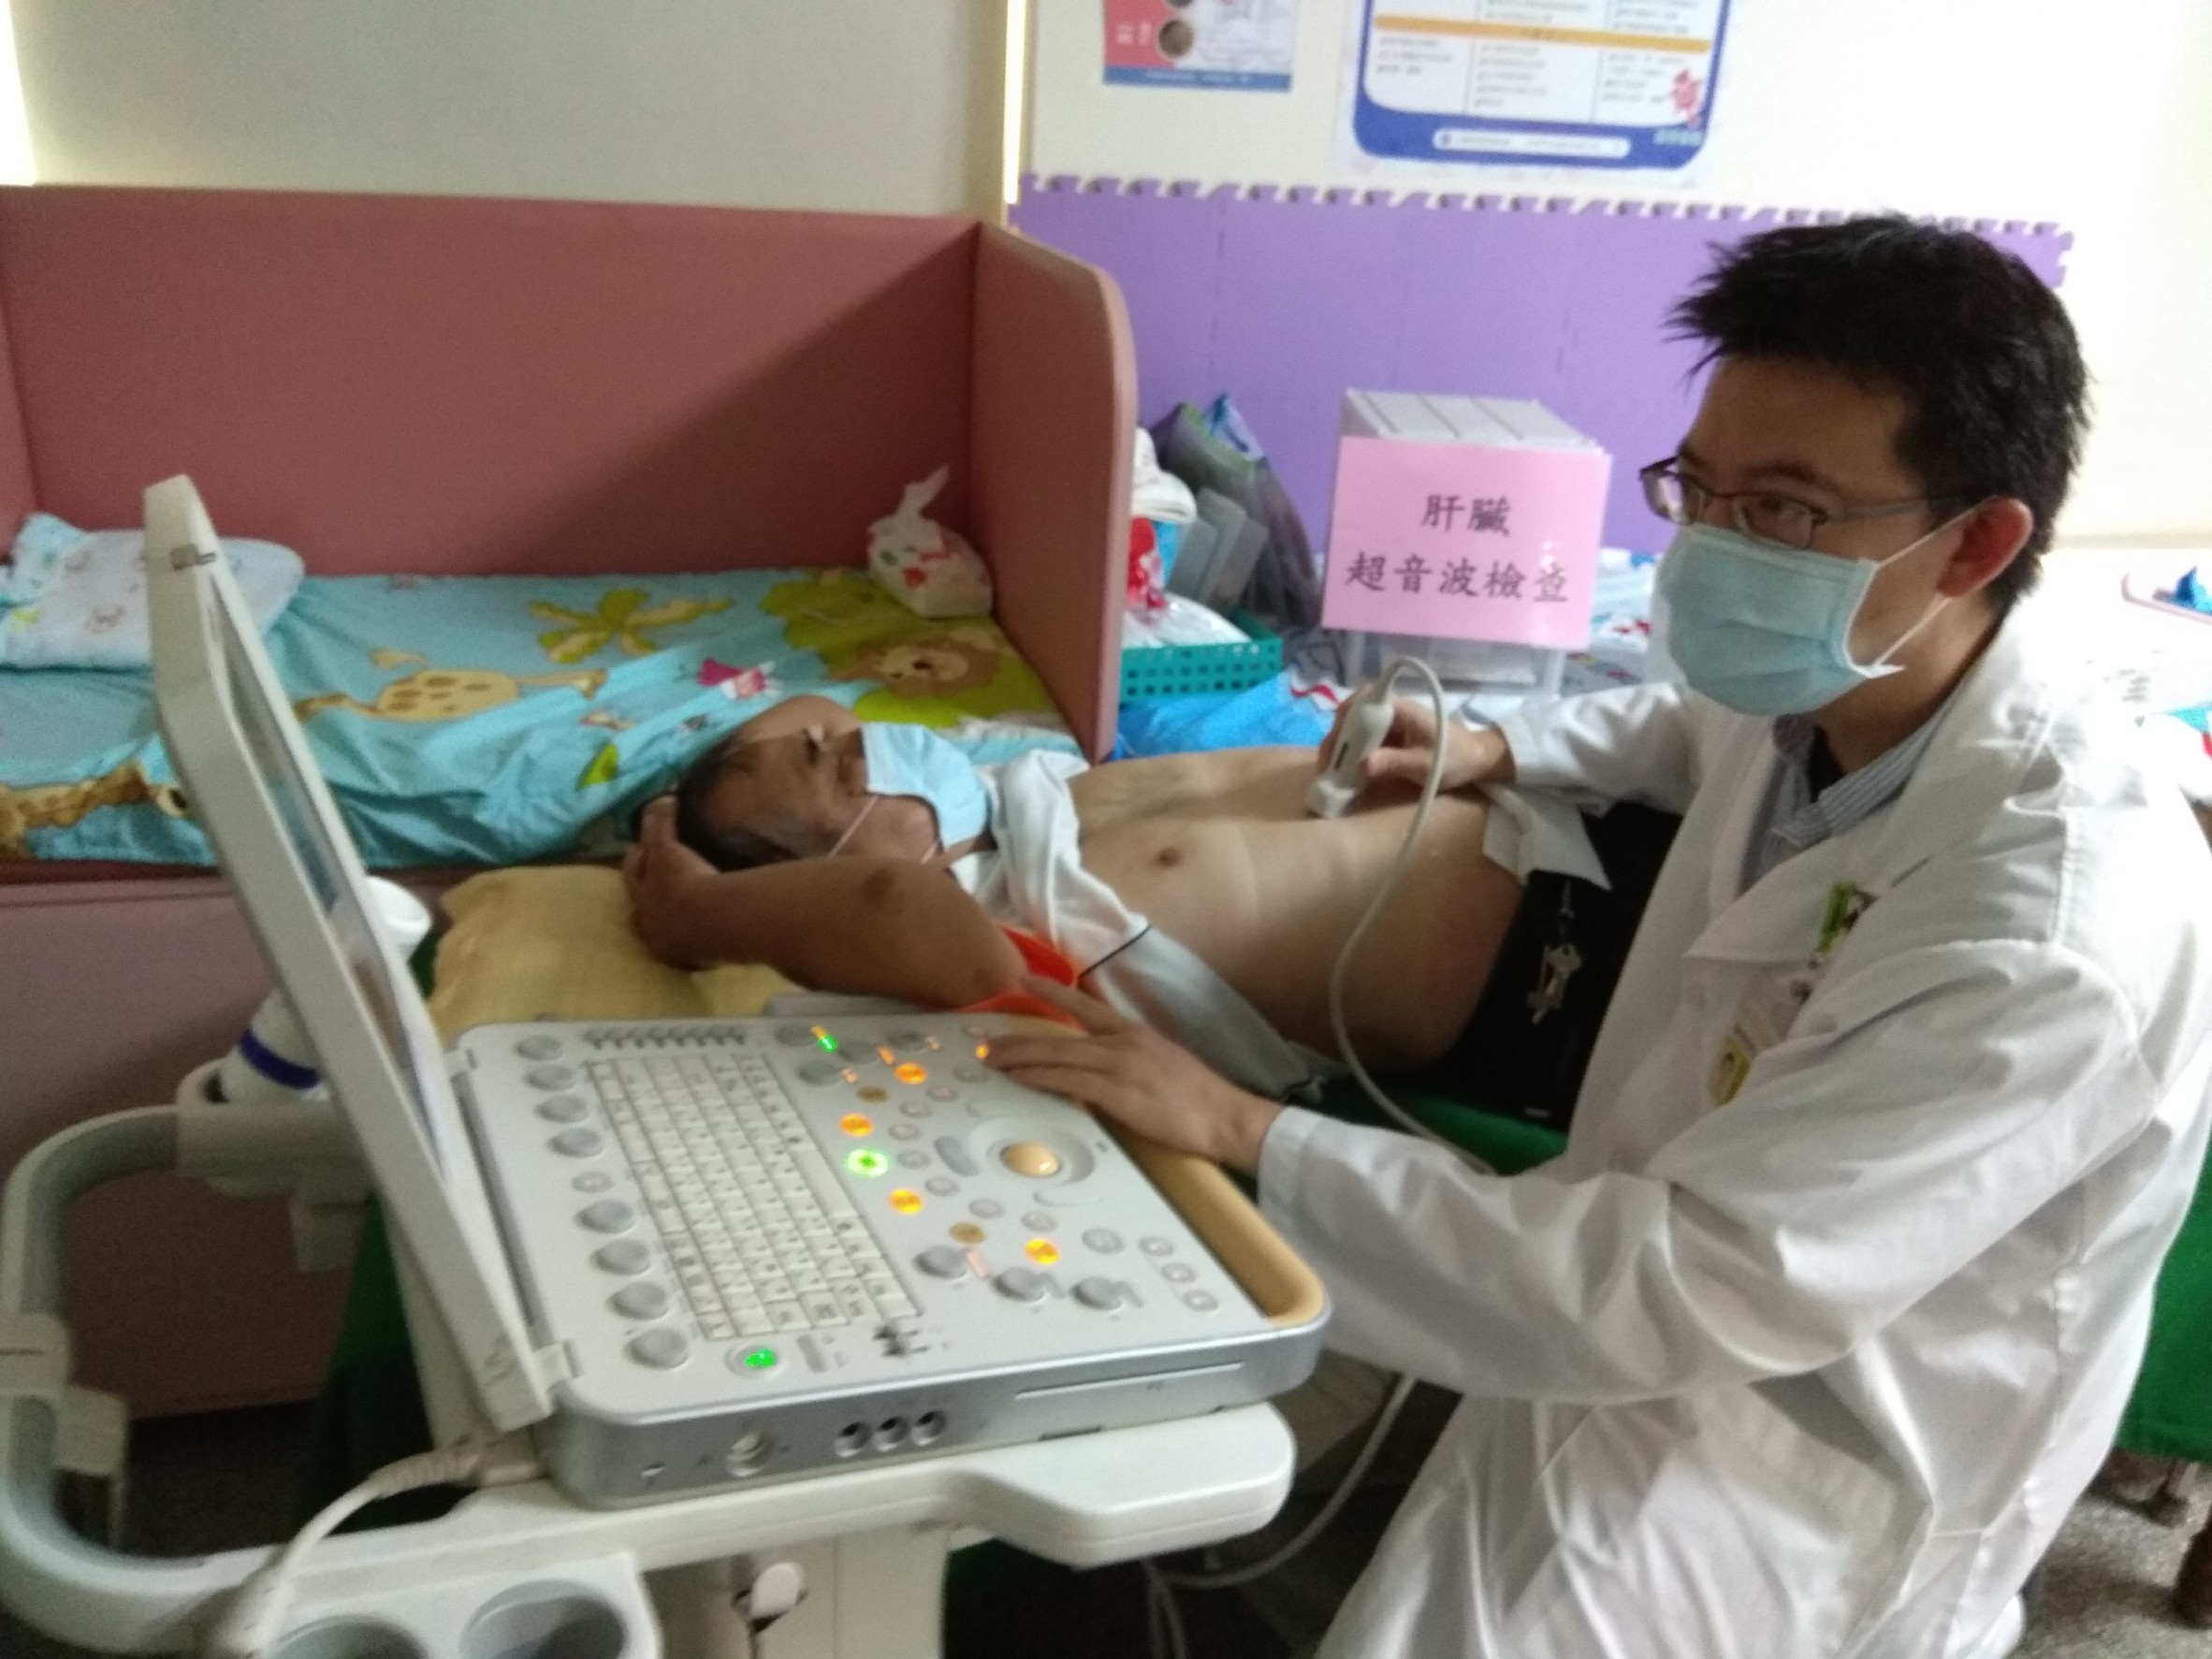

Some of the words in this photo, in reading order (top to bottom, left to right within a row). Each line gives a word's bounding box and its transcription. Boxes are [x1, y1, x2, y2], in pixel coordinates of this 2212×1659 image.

[1420, 493, 1511, 537] 肝臟
[1345, 551, 1569, 604] 超音波檢查
